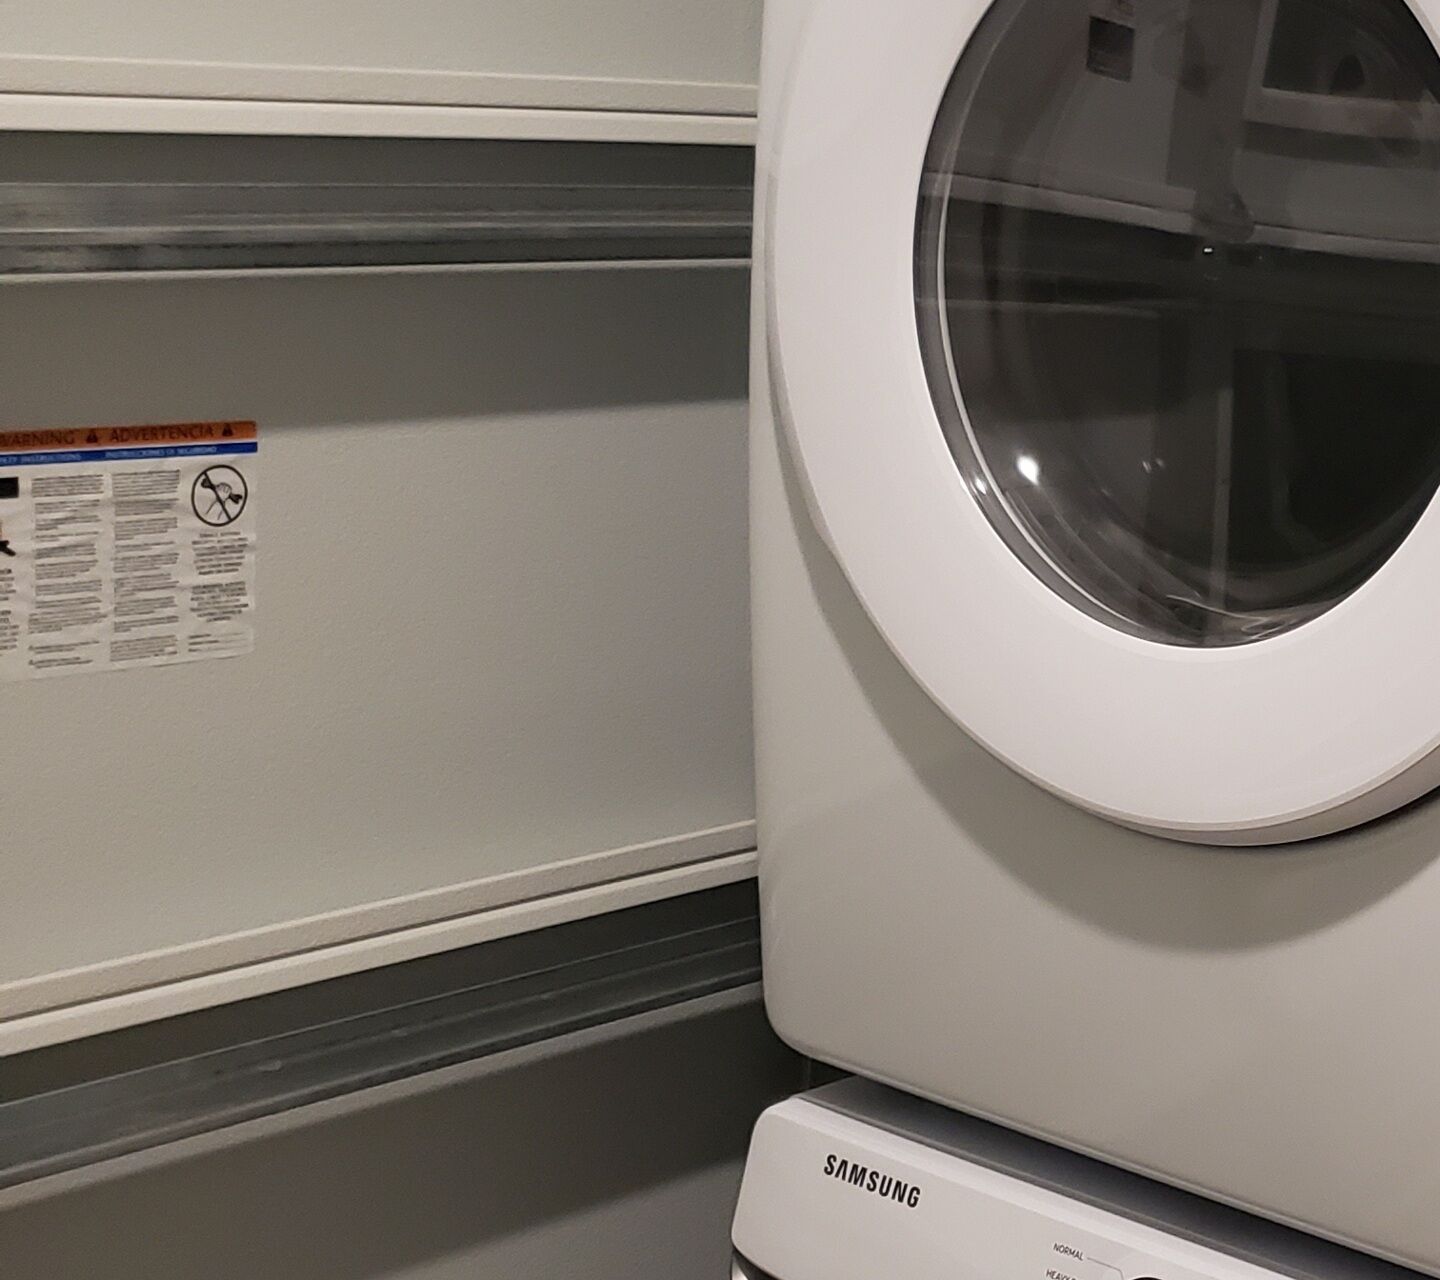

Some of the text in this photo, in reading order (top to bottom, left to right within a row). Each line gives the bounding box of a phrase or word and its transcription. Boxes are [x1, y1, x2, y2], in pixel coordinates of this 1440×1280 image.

[110, 424, 214, 443] ADVERTENCIA
[824, 1154, 921, 1208] SAMSUNG
[1053, 1243, 1084, 1261] NORMAL
